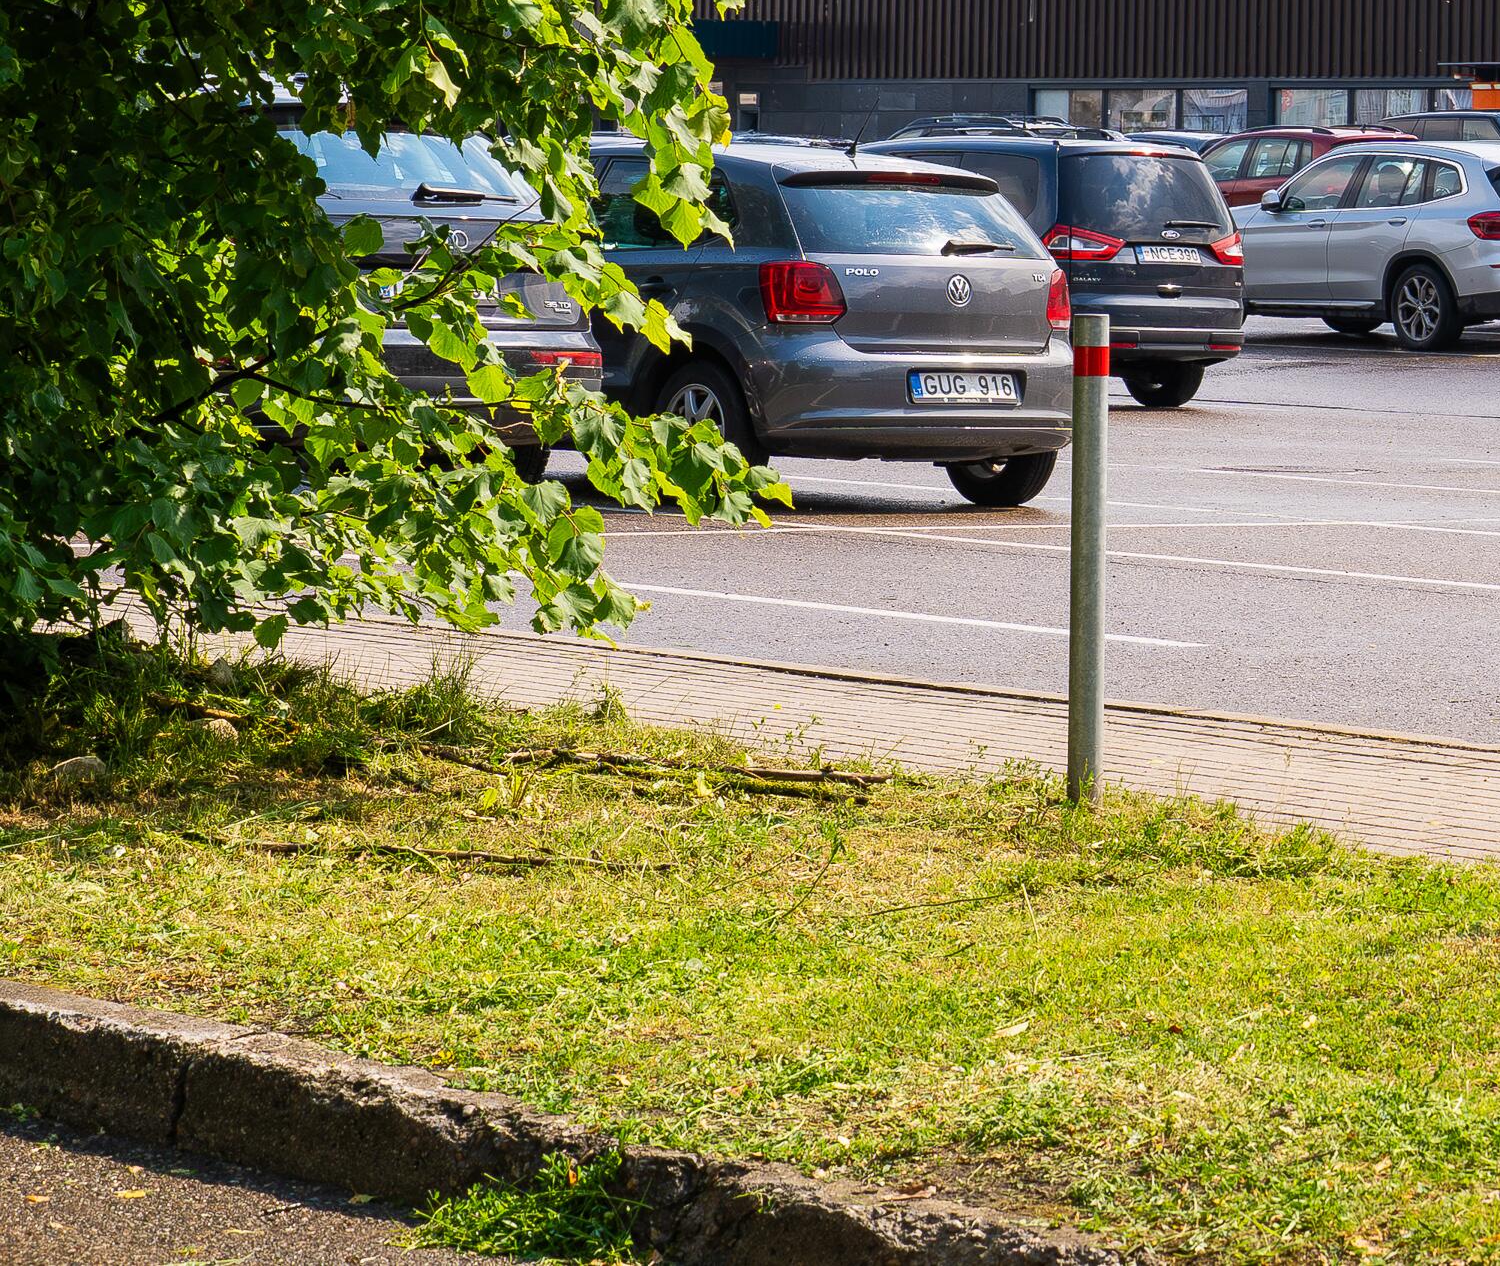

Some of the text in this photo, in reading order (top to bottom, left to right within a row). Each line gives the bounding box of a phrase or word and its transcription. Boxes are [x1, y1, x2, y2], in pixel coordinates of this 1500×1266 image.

[845, 268, 880, 277] POLO
[1032, 273, 1046, 283] TDI
[923, 374, 1012, 396] GUG 916
